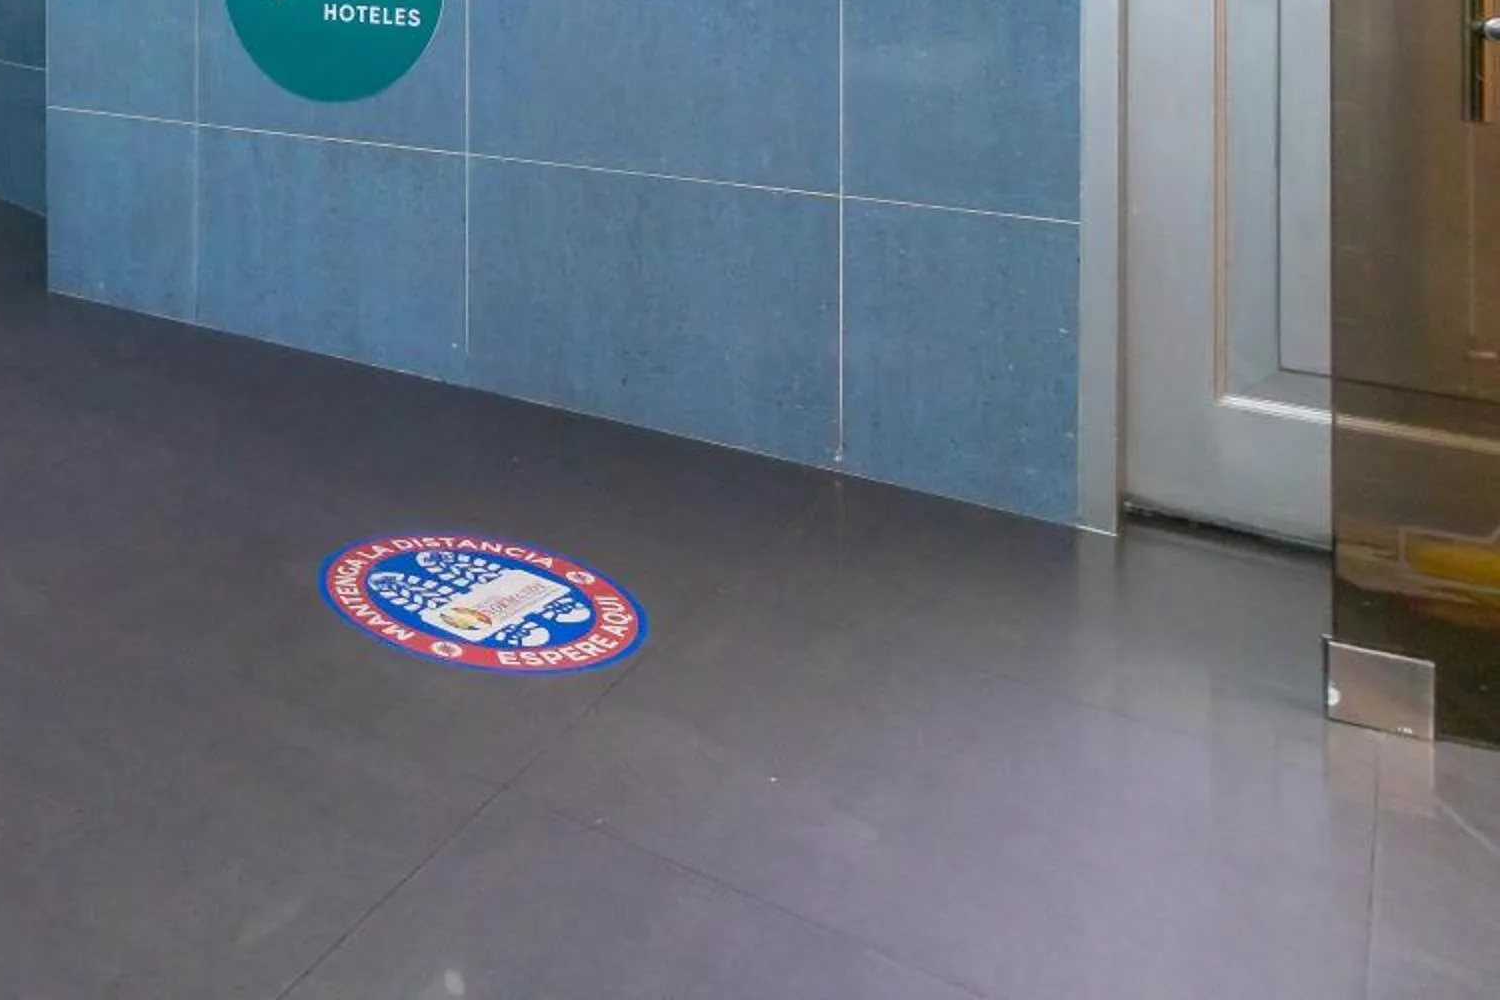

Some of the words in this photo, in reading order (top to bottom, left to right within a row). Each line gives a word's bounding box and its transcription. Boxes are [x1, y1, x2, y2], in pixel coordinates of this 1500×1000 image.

[323, 3, 422, 28] HOTELES
[359, 545, 396, 561] LA
[393, 536, 556, 569] DISTANCIA
[334, 558, 416, 642] MANTENGA
[496, 636, 621, 666] ESPERE
[595, 595, 631, 640] AQUI
